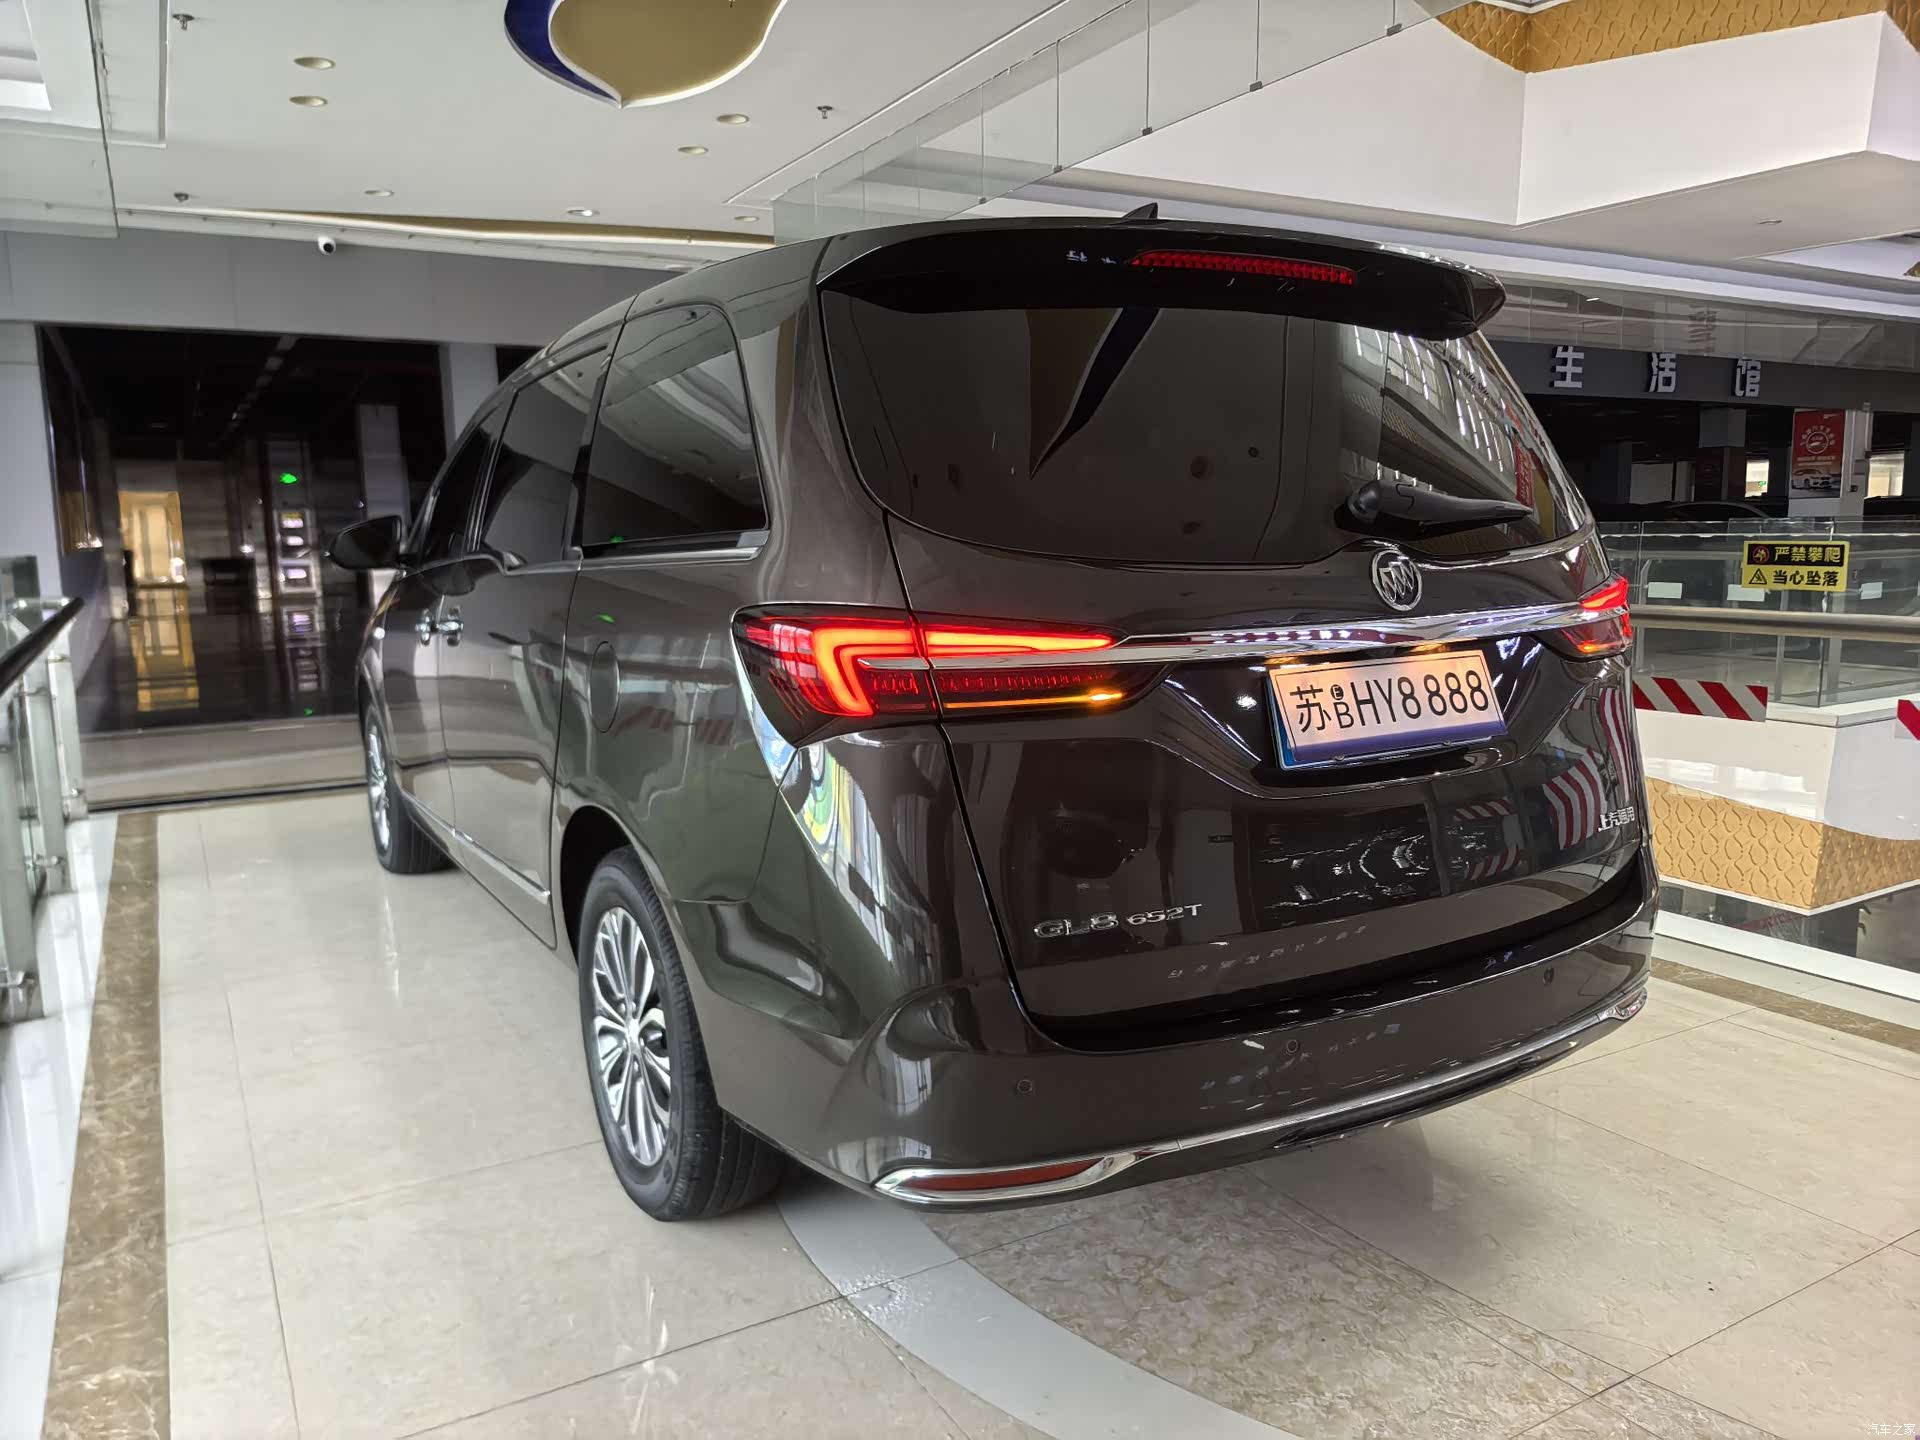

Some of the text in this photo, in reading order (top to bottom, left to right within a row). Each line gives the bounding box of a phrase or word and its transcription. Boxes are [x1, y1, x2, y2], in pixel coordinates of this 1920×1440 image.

[1552, 345, 1762, 398] 生活馆
[1774, 545, 1841, 563] 严禁攀爬
[1772, 569, 1839, 587] 当心坠落
[1598, 806, 1635, 832] 上汽通用
[1033, 903, 1203, 938] GL8 652T
